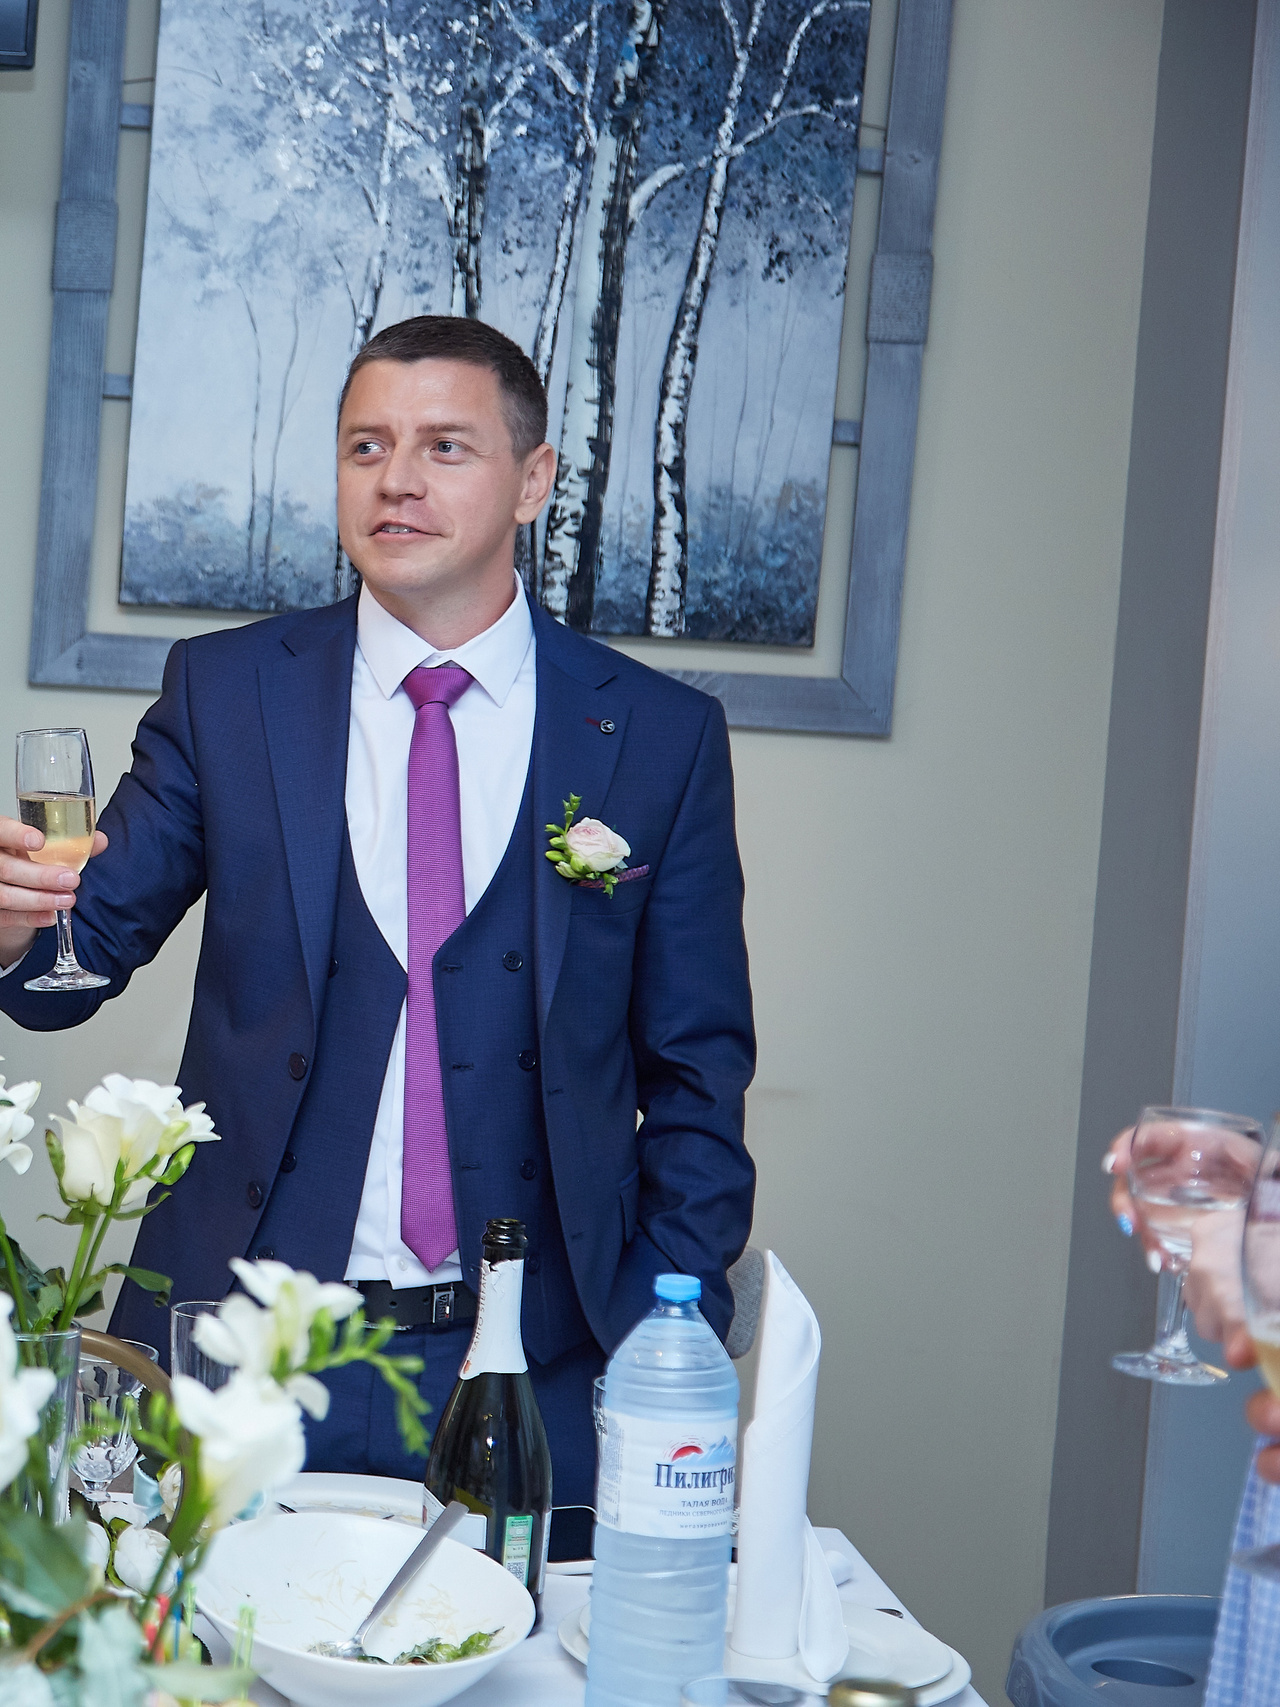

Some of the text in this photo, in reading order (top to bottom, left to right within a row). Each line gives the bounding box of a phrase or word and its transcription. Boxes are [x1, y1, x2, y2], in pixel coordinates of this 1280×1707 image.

[471, 1317, 484, 1353] SANTO
[654, 1463, 736, 1494] Пилигри
[680, 1500, 710, 1508] ТАЛАЯ
